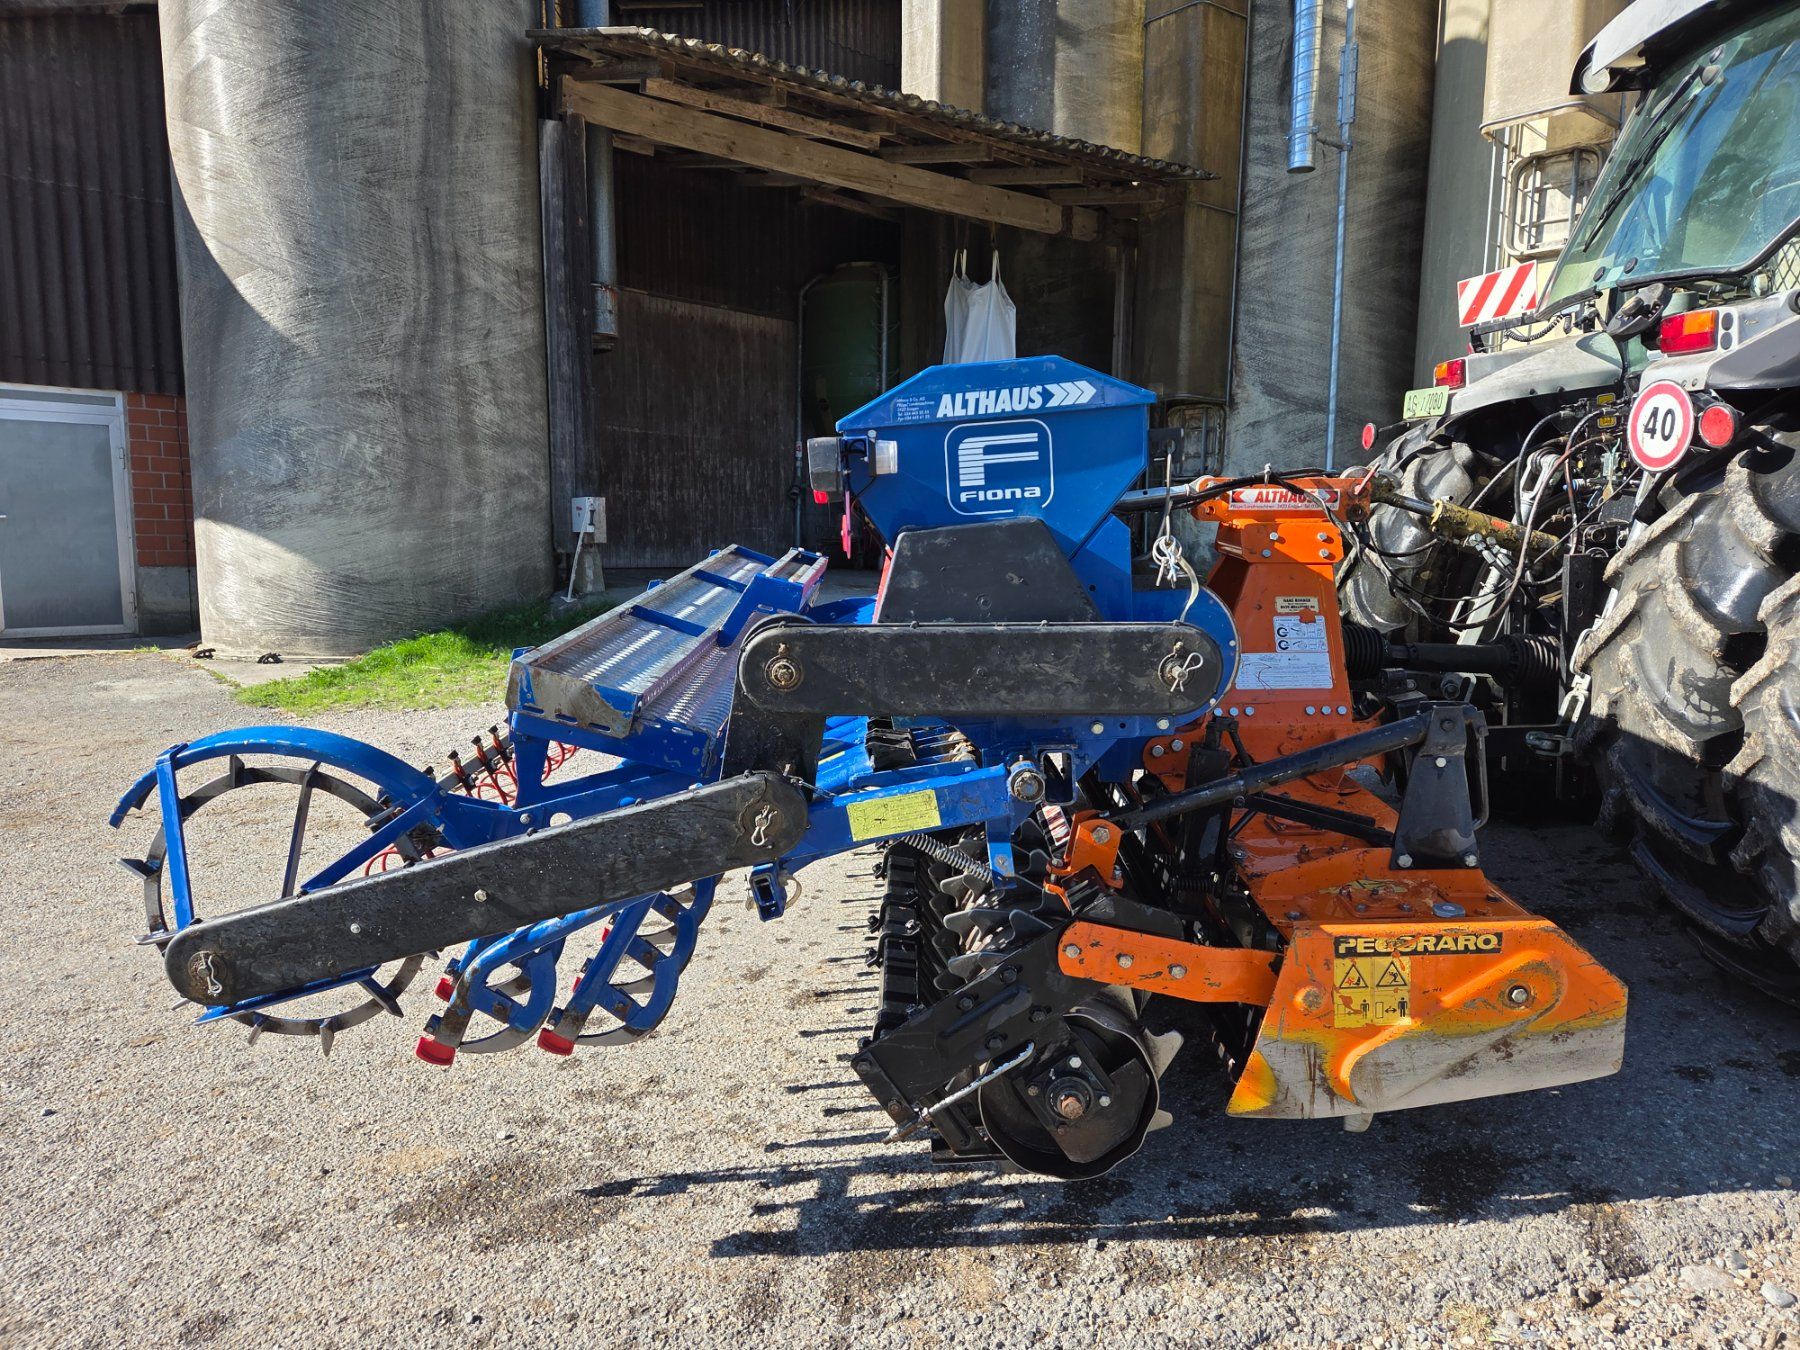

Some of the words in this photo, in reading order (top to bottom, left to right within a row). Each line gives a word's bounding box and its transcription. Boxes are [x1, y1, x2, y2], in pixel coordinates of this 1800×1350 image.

[936, 385, 1043, 418] ALTHAUS
[1643, 406, 1676, 442] 40
[959, 486, 1041, 503] Fiona
[1254, 490, 1316, 503] ALTHAU
